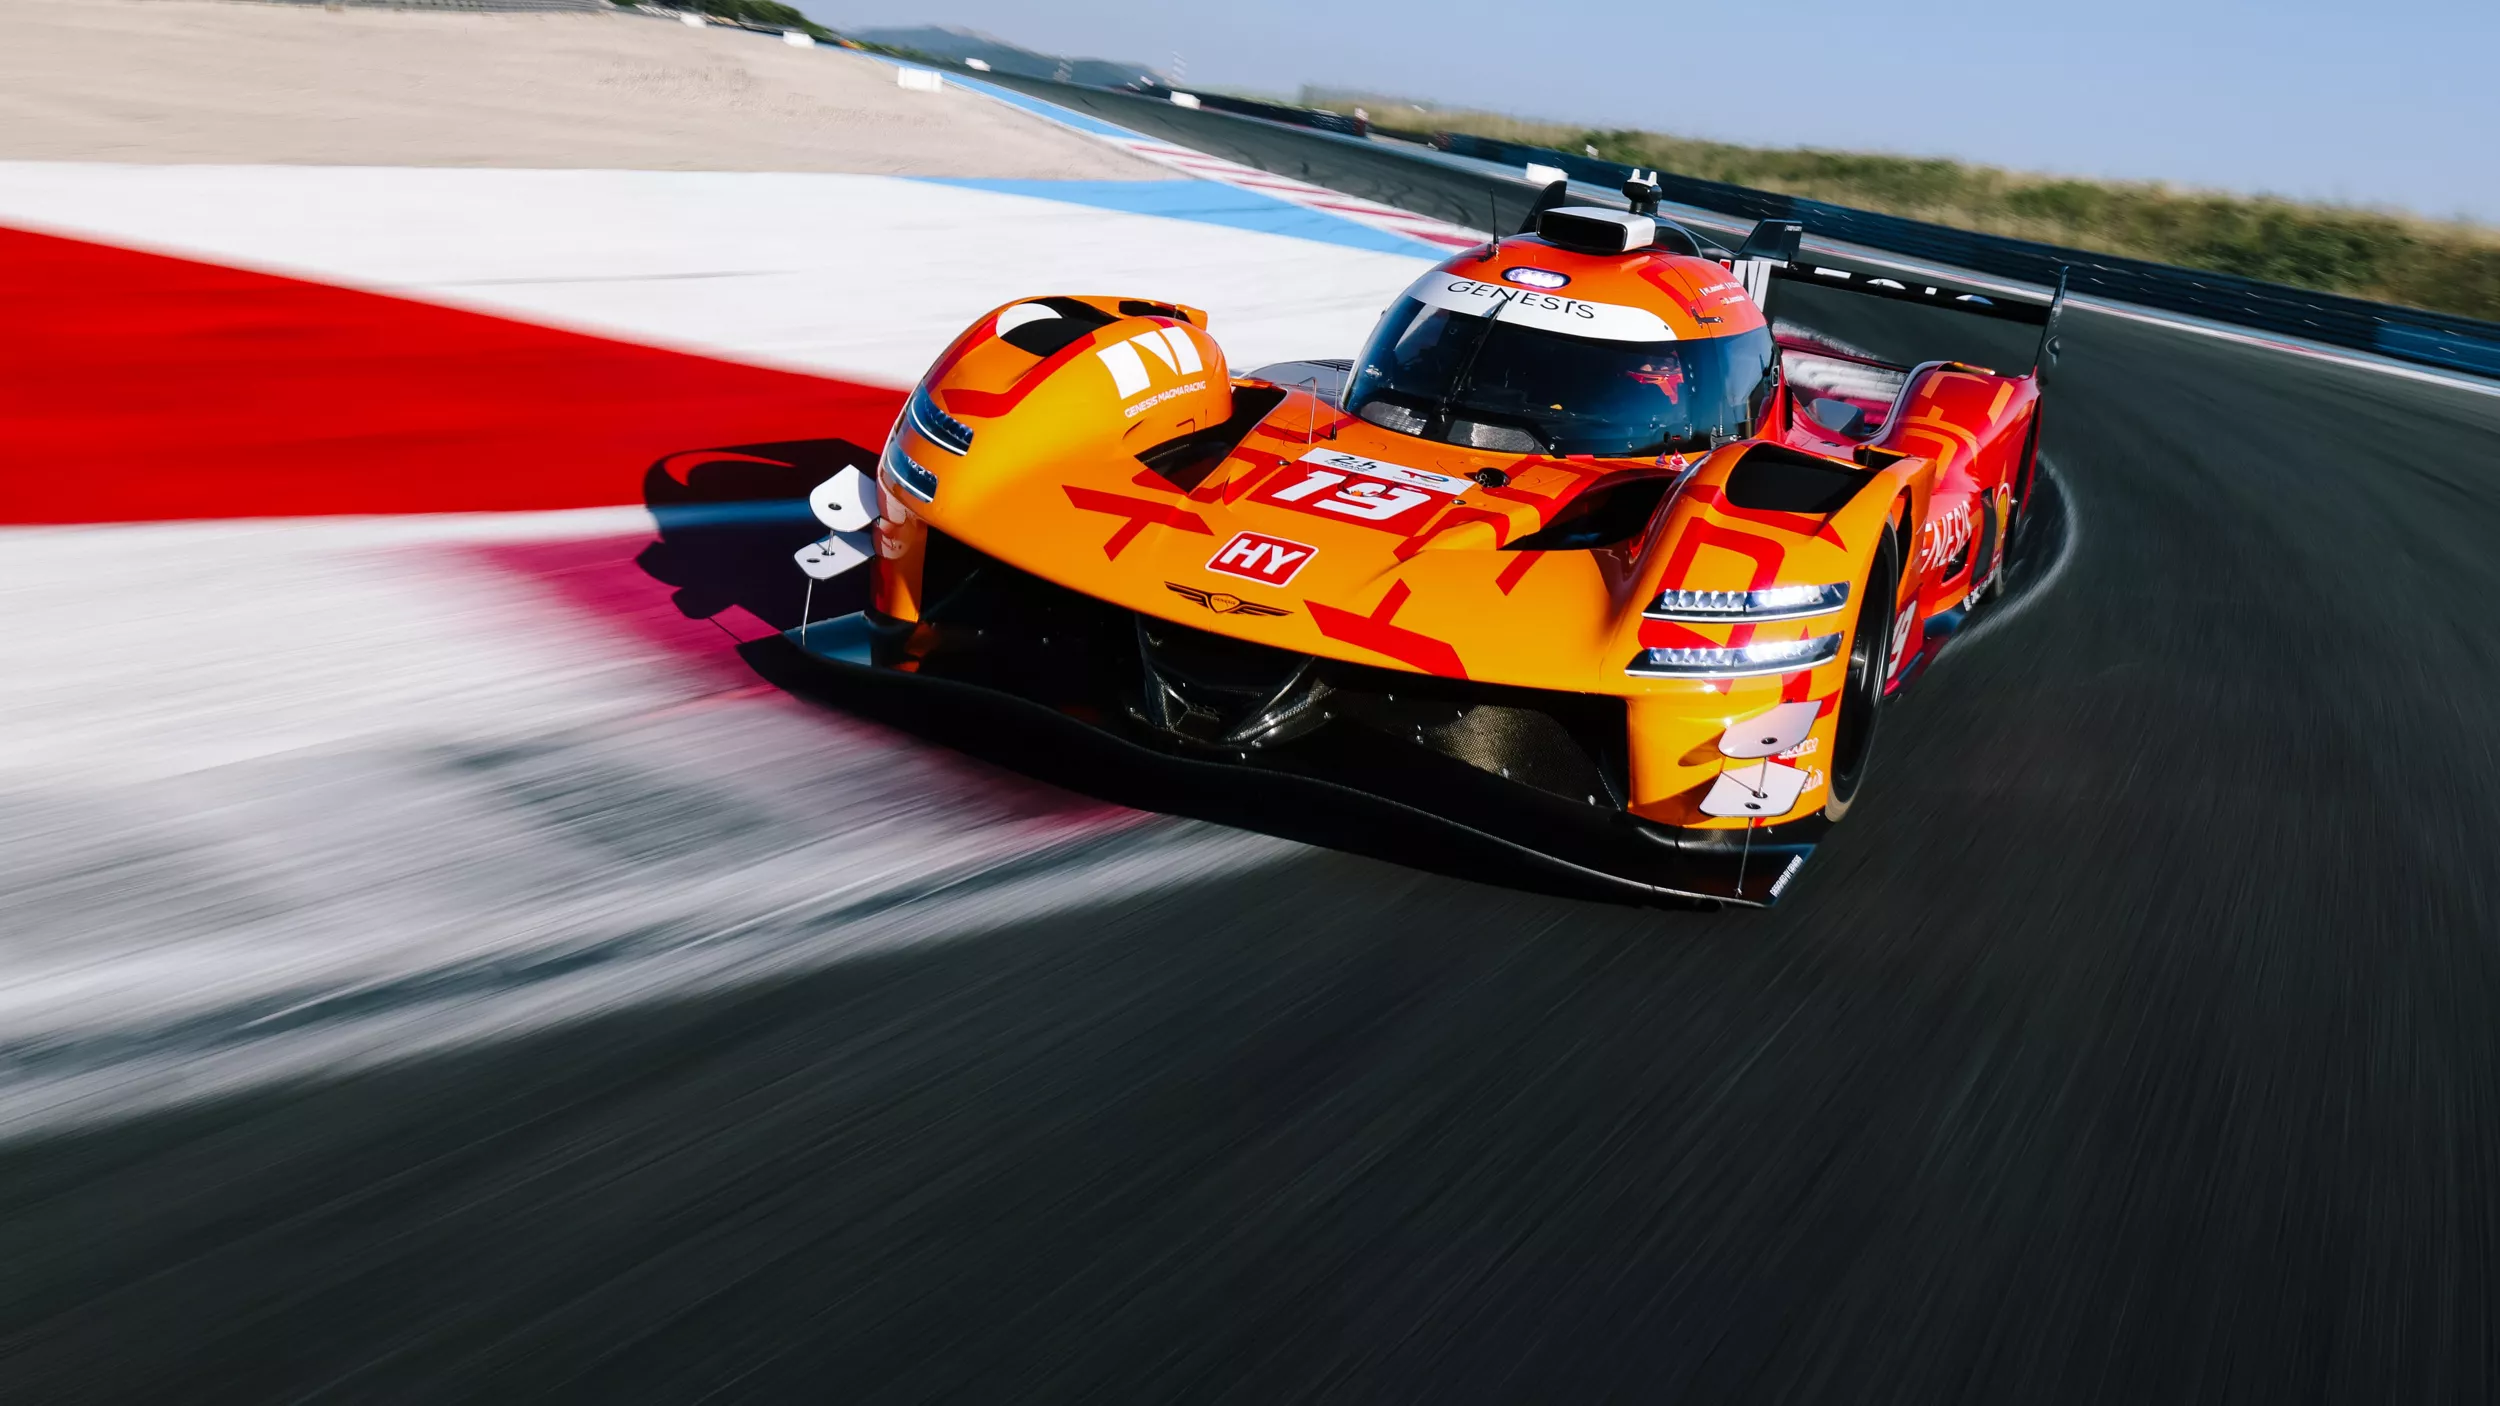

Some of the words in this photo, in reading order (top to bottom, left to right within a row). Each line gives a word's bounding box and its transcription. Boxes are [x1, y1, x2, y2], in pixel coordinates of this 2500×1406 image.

[1447, 280, 1595, 320] GENESIS
[1124, 395, 1159, 418] GENESIS
[1158, 386, 1185, 403] MAGMA
[1183, 380, 1207, 394] RACING
[1271, 470, 1432, 520] 19
[1219, 538, 1307, 575] HY
